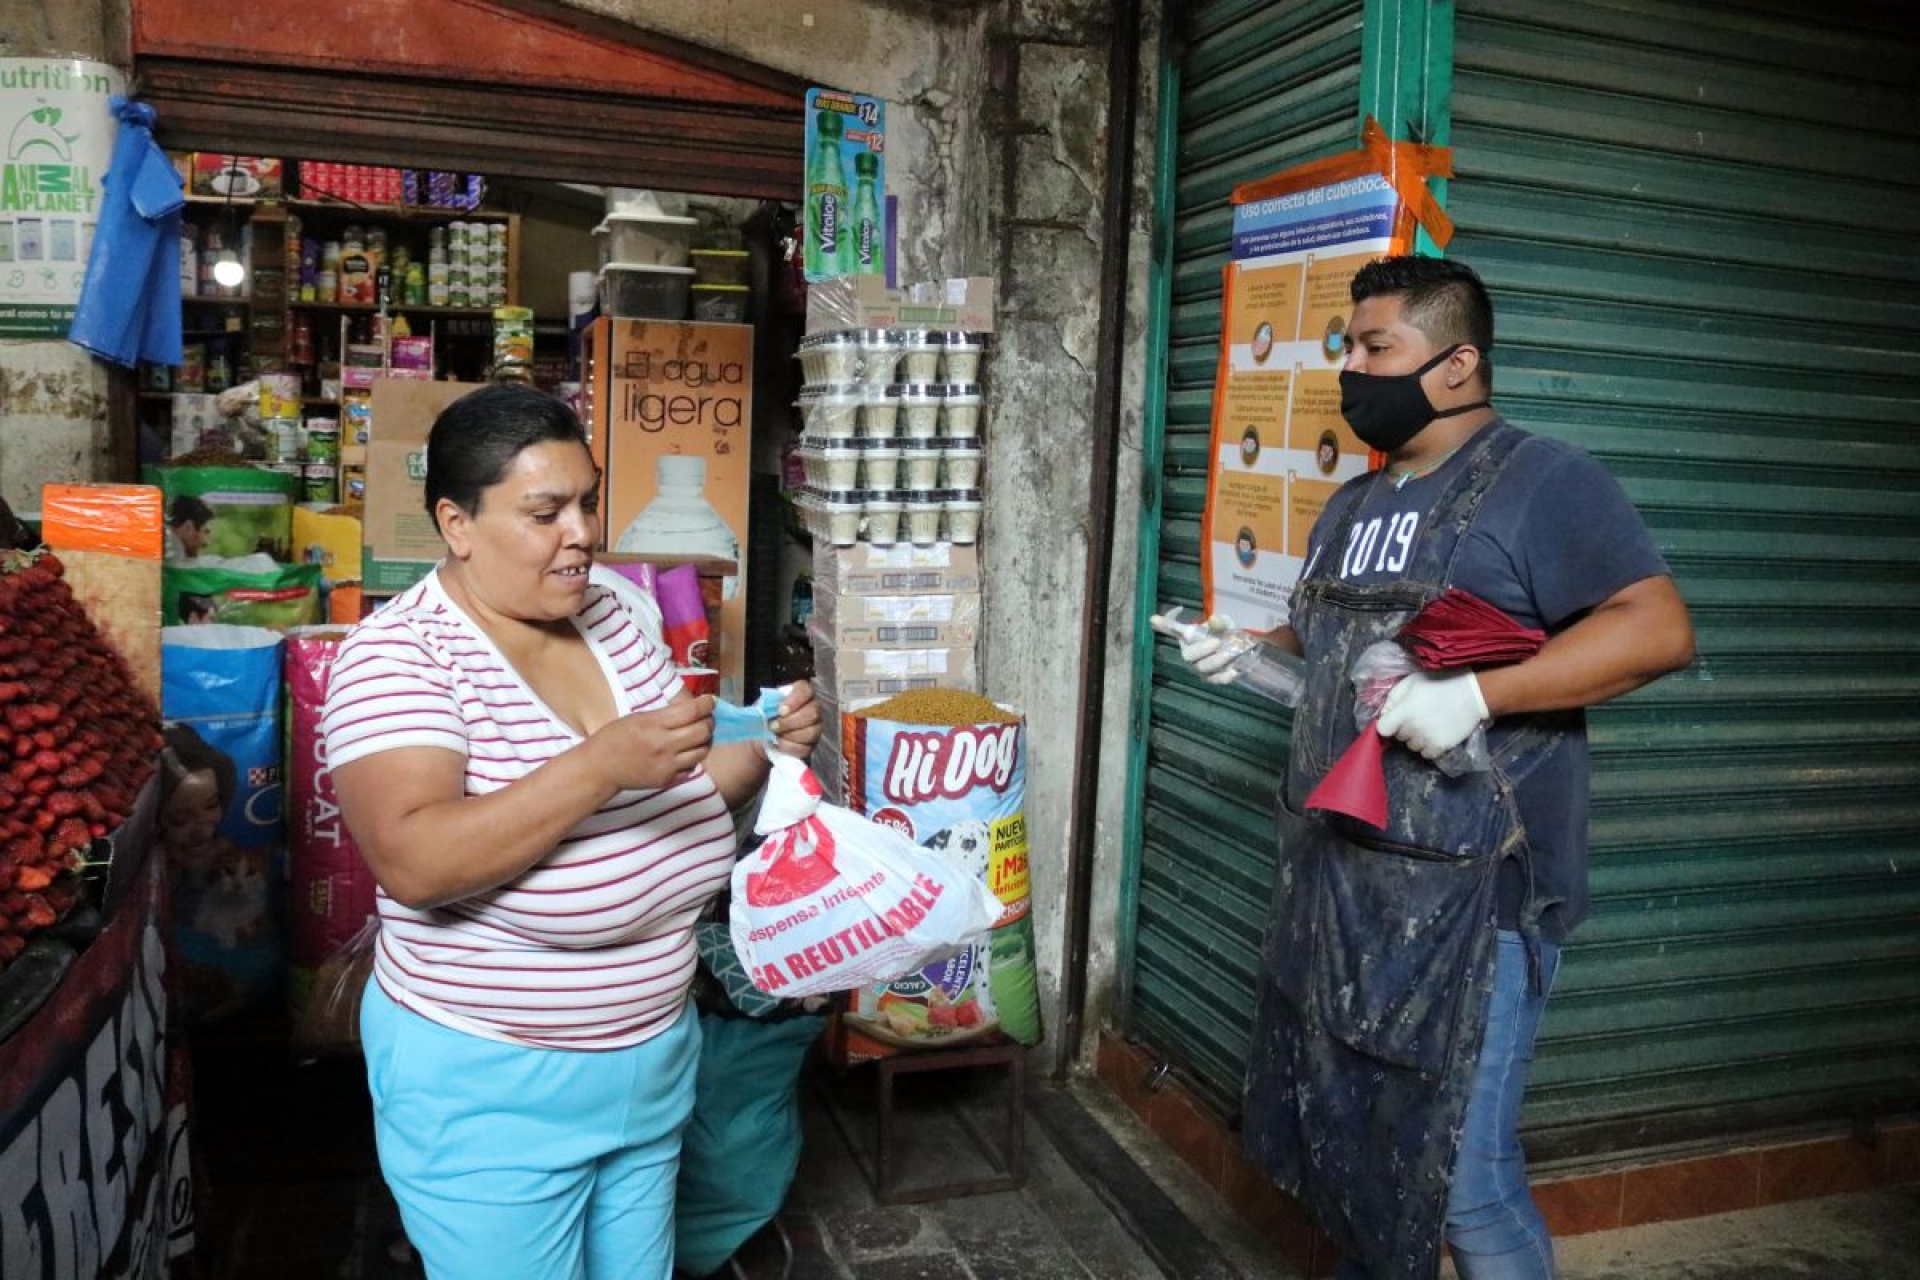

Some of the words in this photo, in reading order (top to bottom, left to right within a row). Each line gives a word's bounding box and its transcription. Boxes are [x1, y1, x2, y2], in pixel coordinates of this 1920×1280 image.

[22, 190, 97, 213] PLANET
[819, 194, 835, 251] Vitaloe
[1241, 203, 1260, 219] Uso
[1262, 194, 1304, 214] correcto
[1306, 186, 1324, 205] del
[859, 219, 871, 263] Vitaloe
[625, 351, 650, 380] El
[663, 359, 743, 388] agua
[623, 383, 743, 433] ligera
[889, 737, 942, 798] Hi
[943, 725, 1018, 793] Dog
